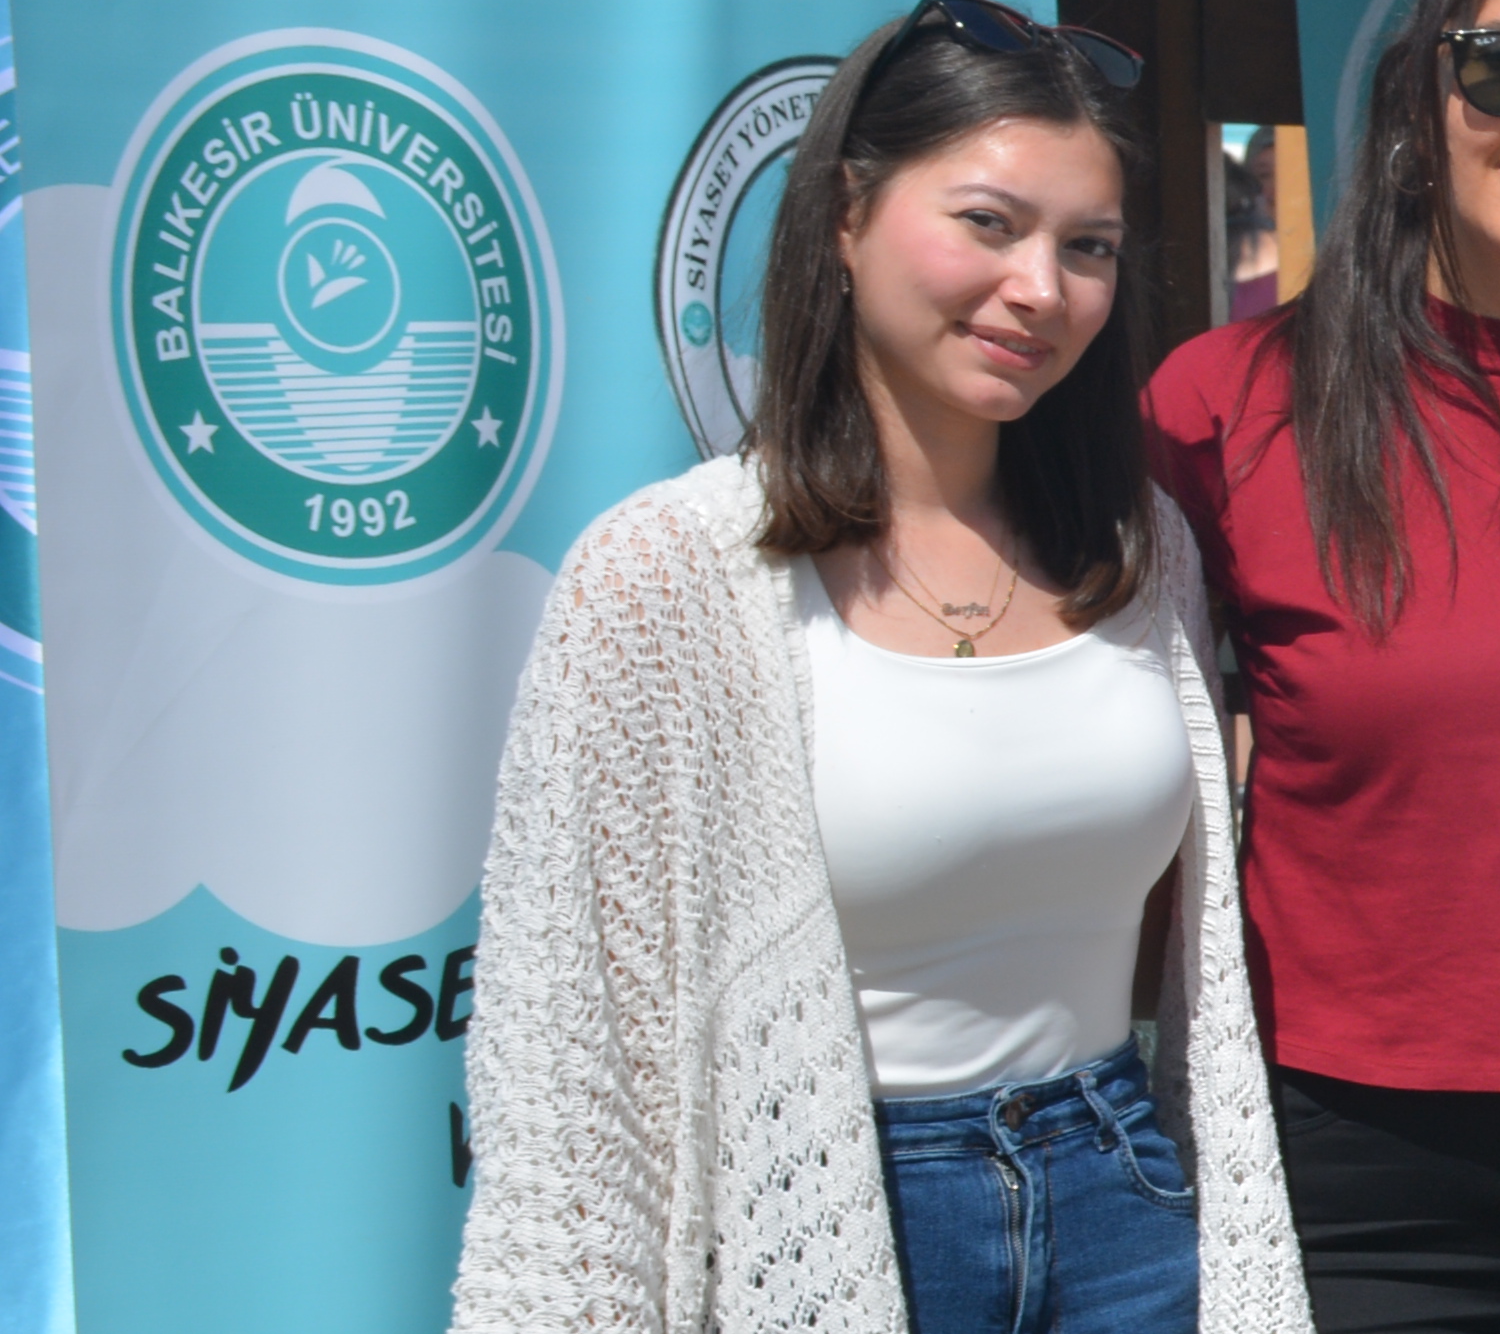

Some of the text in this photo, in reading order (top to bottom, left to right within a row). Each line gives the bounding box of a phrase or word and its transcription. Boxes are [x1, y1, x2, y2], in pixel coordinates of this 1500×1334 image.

[152, 92, 517, 365] BALIKESİR ÜNİVERSİTESİ
[683, 92, 820, 291] SİYASET YÖNET
[304, 489, 417, 537] 1992
[122, 946, 478, 1094] SİYASE
